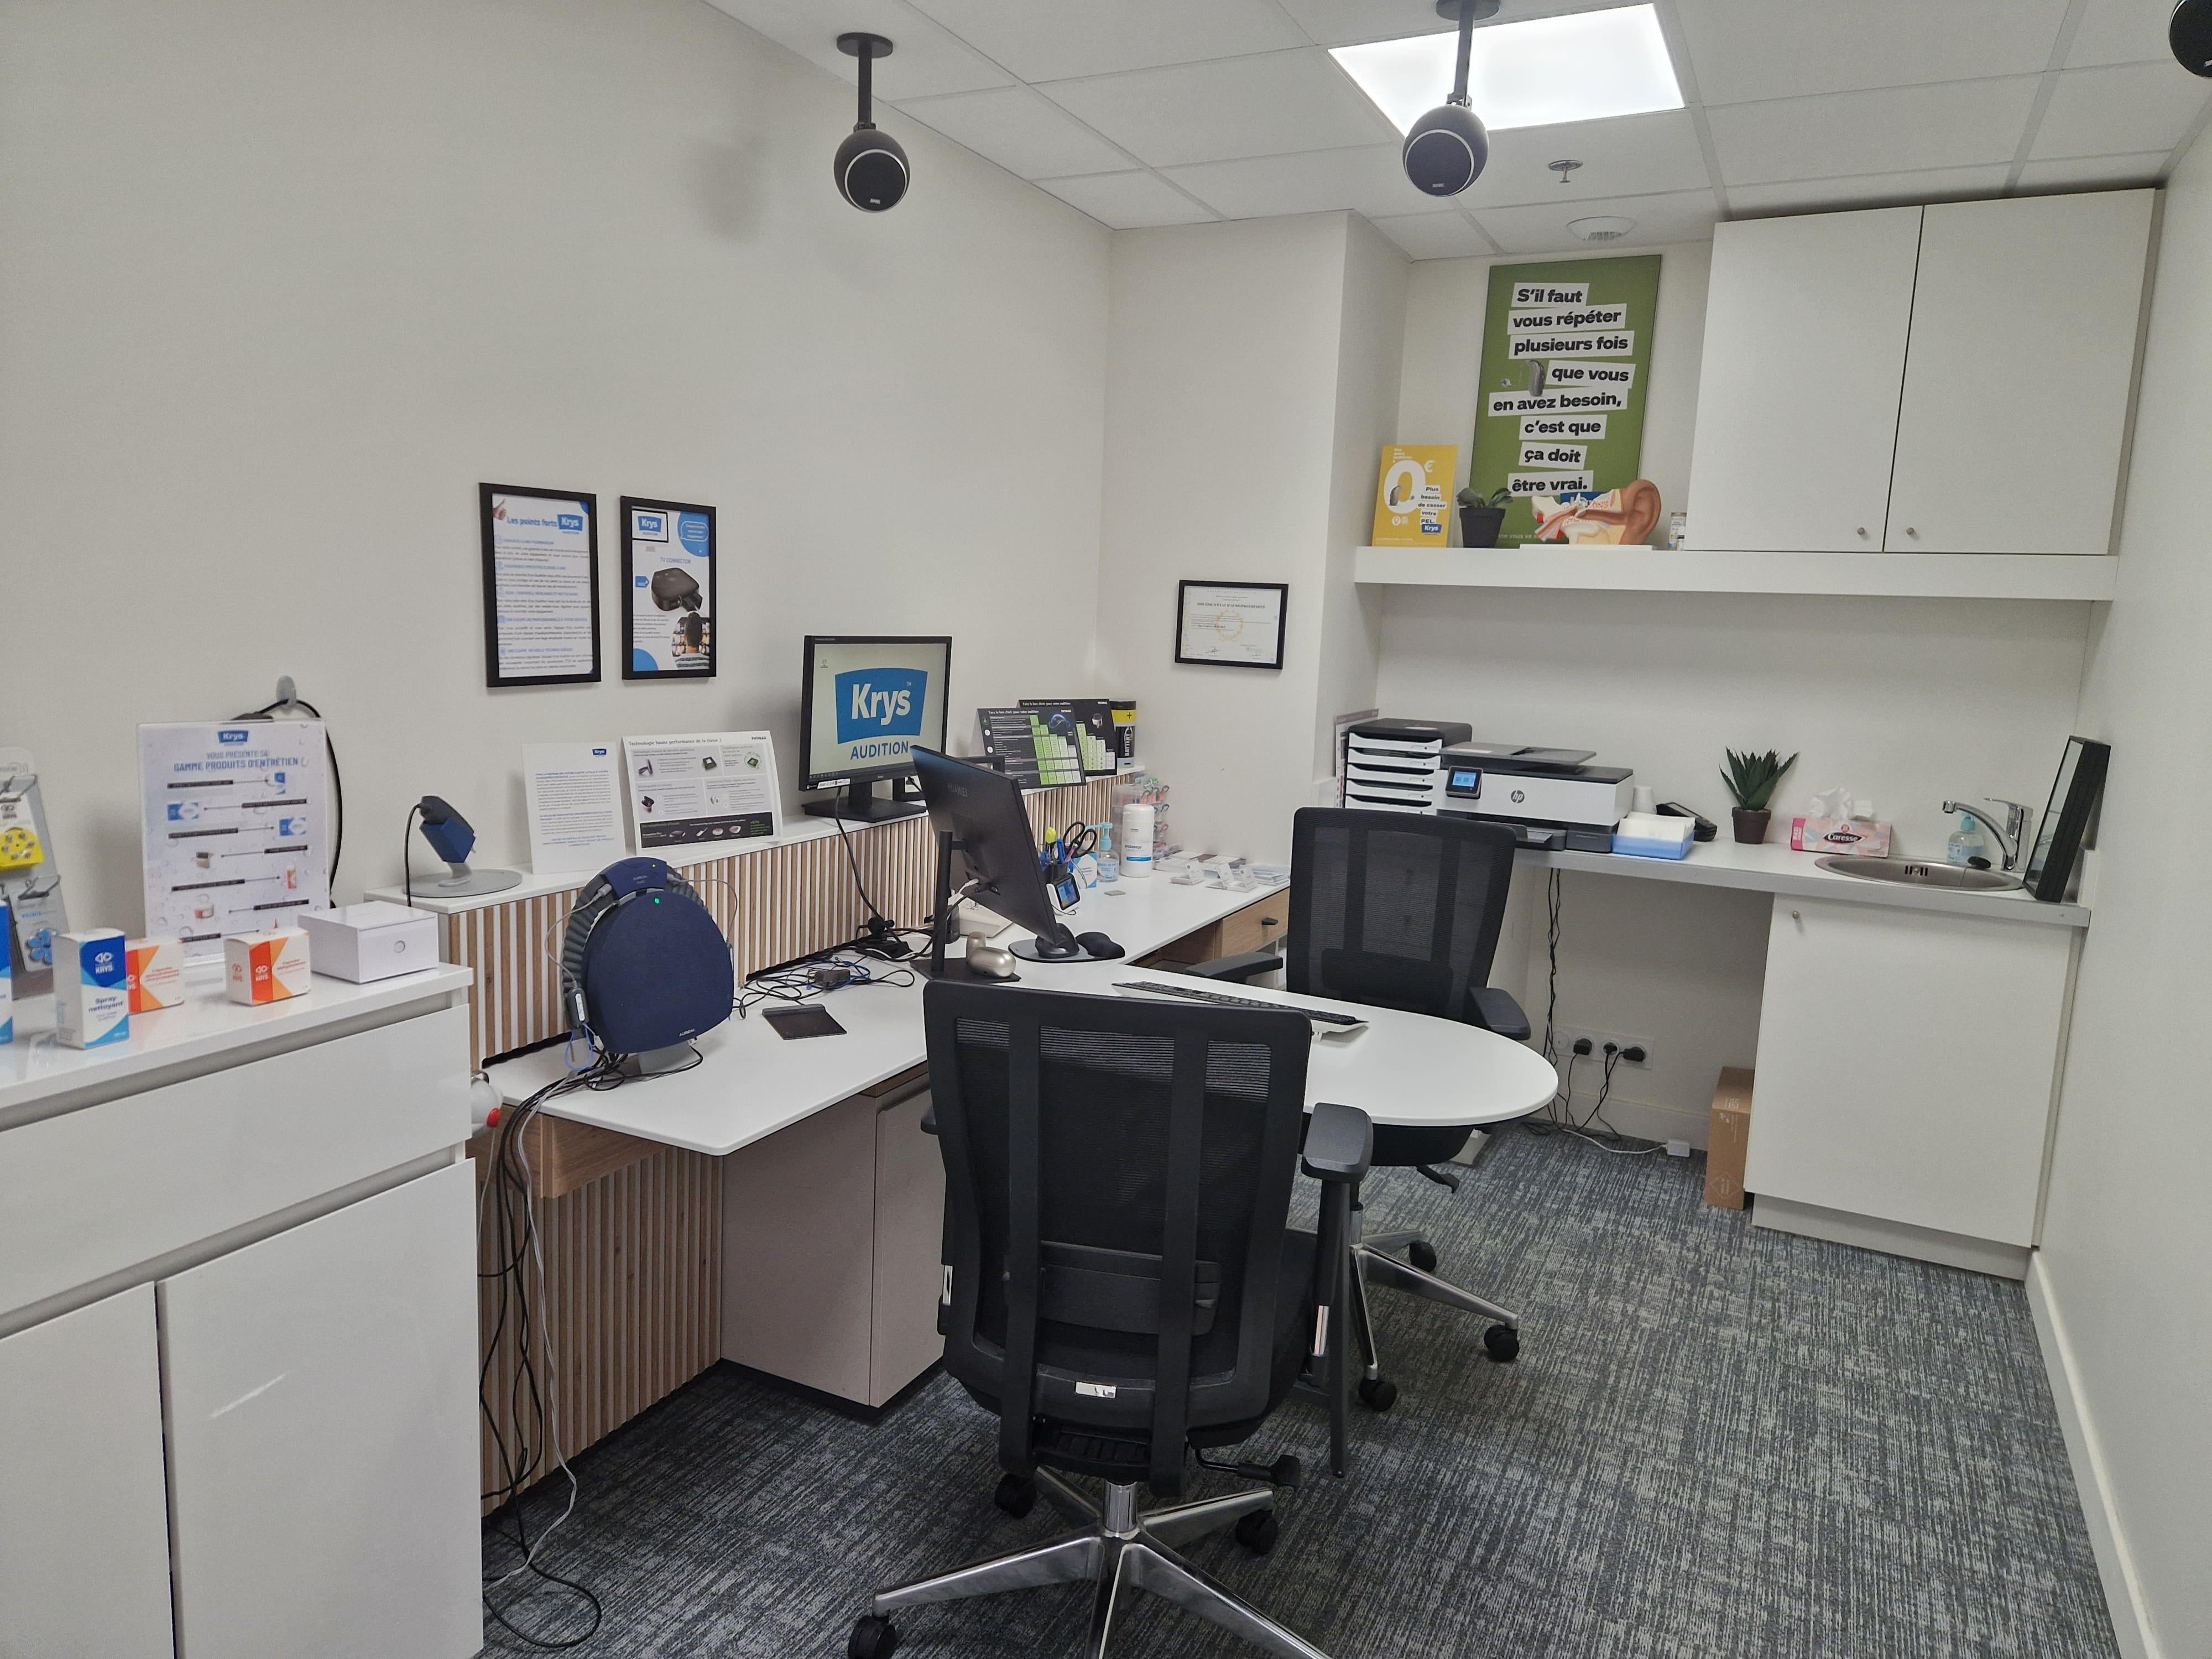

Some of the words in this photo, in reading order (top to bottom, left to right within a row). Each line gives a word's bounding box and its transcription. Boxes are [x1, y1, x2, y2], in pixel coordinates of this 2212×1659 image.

[1517, 289, 1545, 302] S'il
[1548, 290, 1583, 303] faut
[1513, 314, 1553, 327] vous
[1557, 309, 1621, 330] répéter
[1514, 338, 1593, 356] plusieurs
[1597, 336, 1628, 349] fois
[1552, 367, 1584, 382] que
[1589, 369, 1629, 382] vous
[1493, 399, 1514, 411] en
[1517, 398, 1556, 411] avez
[1559, 392, 1621, 408] besoin,
[1525, 420, 1564, 433] c'est
[1569, 422, 1601, 436] que
[1525, 449, 1544, 462] ça
[1548, 448, 1580, 462] doit
[1512, 478, 1546, 492] être
[1550, 477, 1588, 491] vrai.
[561, 517, 580, 528] Krys
[641, 518, 658, 529] Krys
[852, 684, 911, 726] Krys
[223, 732, 243, 741] Krys
[850, 741, 909, 760] AUDITION
[174, 761, 202, 771] GAMME
[205, 759, 245, 770] PRODUITS
[1511, 790, 1525, 803] hp
[1828, 833, 1859, 842] Caresse
[88, 1000, 124, 1013] nettoyant
[95, 995, 117, 1005] Spray
